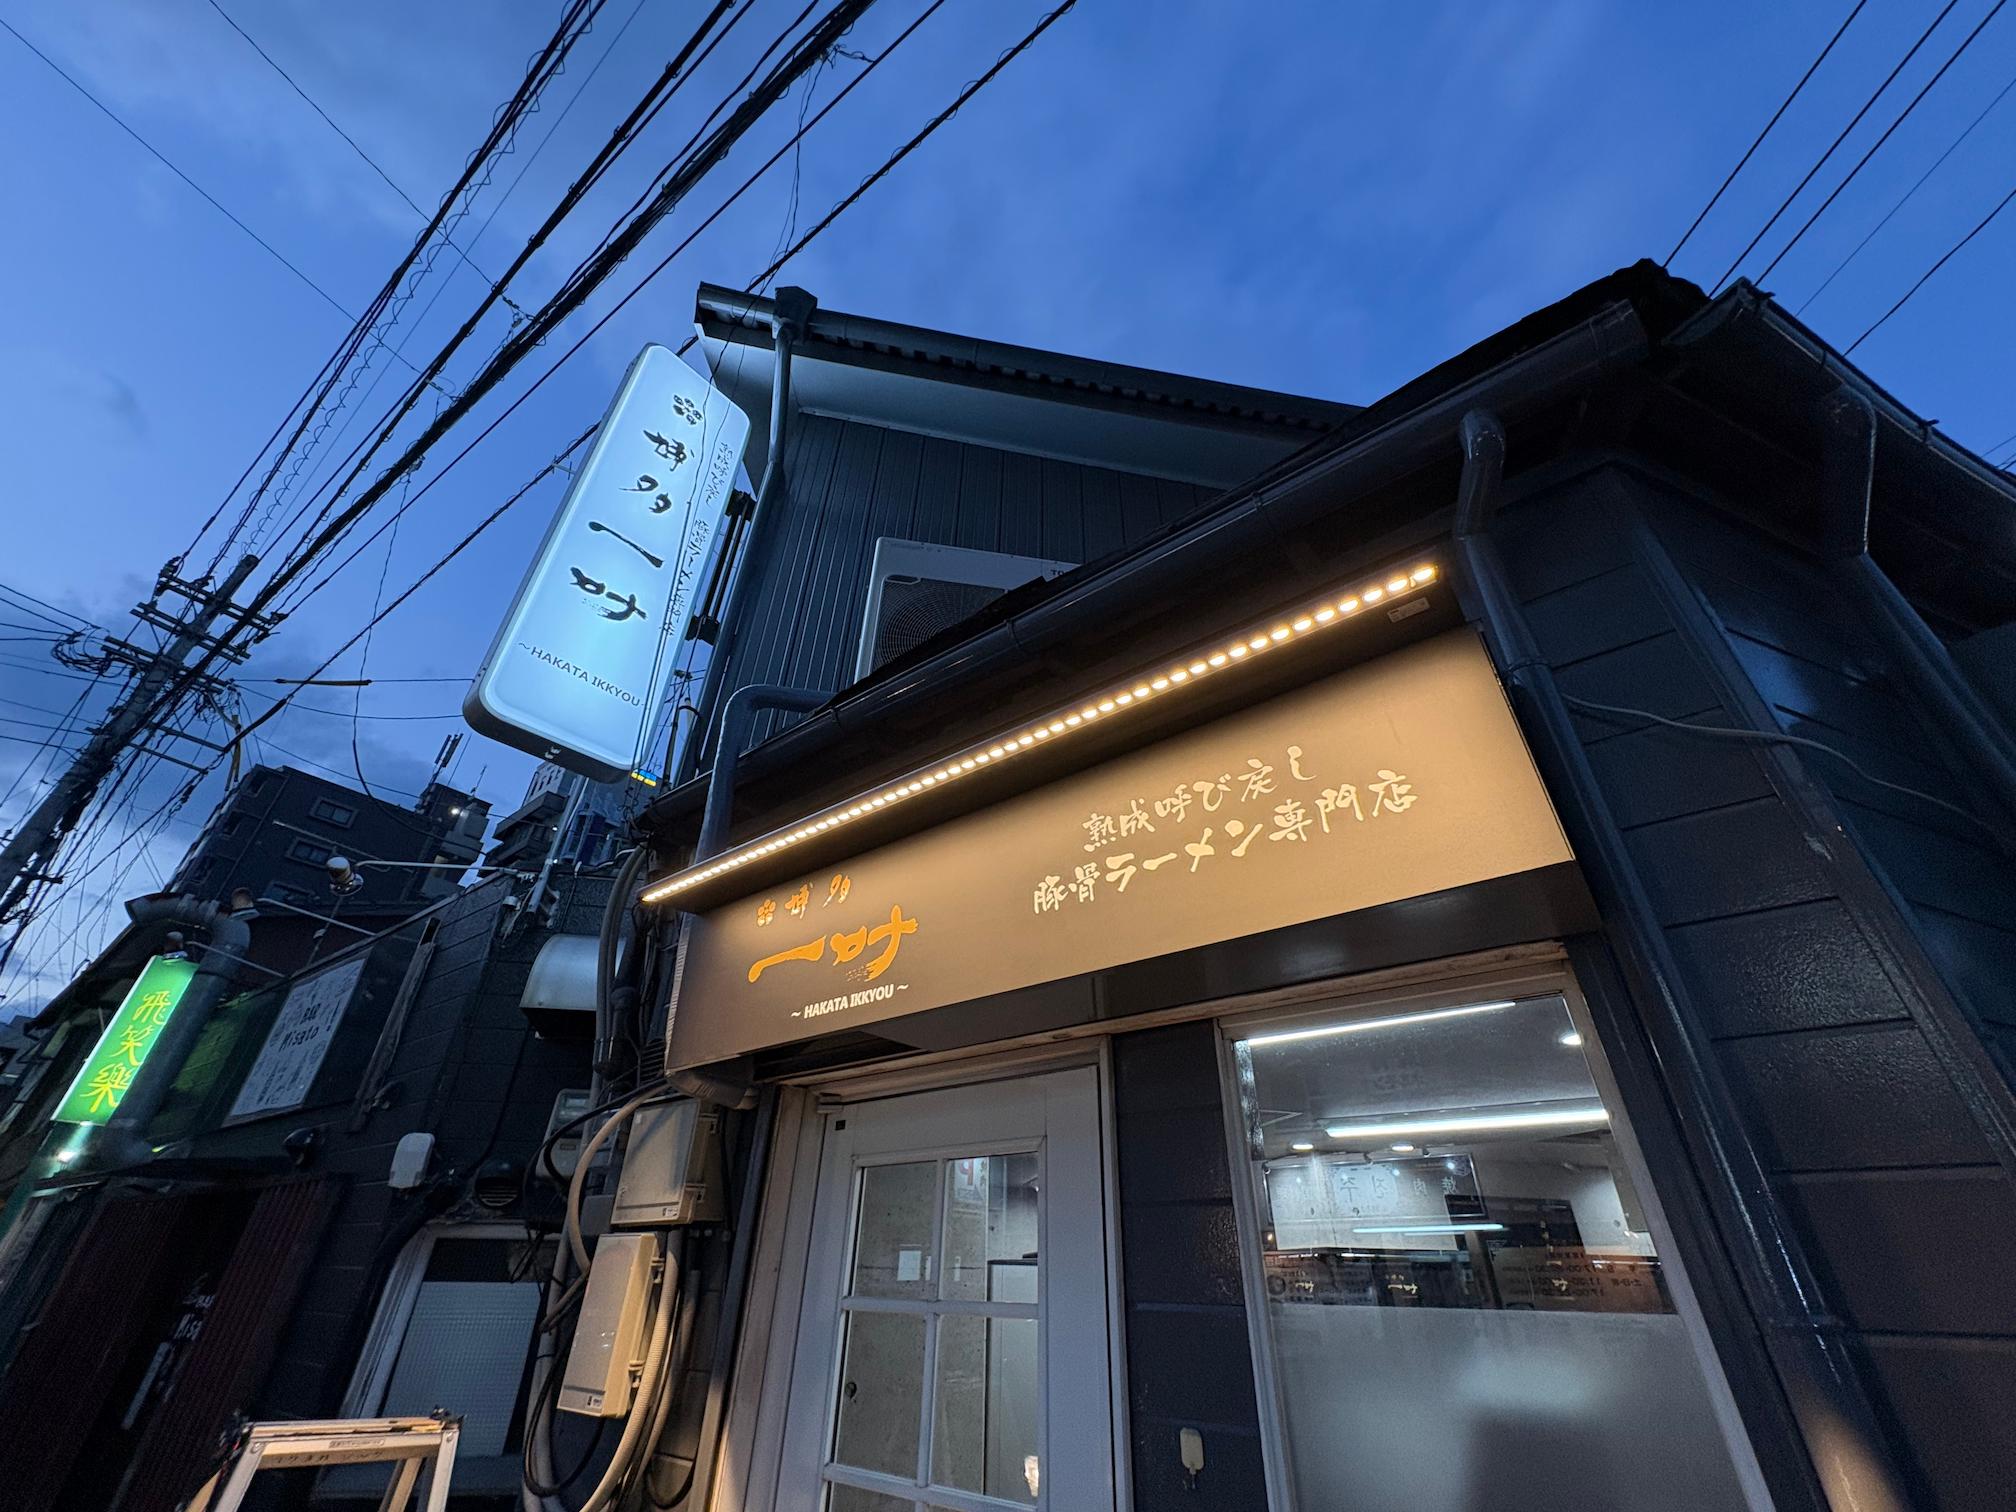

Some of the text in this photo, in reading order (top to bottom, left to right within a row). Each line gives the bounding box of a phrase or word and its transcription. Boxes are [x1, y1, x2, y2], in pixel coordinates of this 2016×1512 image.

[1082, 745, 1317, 852] 熟成呼び戻し
[1033, 769, 1418, 914] 豚骨ラーメン専門店
[784, 873, 851, 919] 博多
[804, 996, 848, 1018] HAKATA
[850, 984, 894, 1007] IKKYOU
